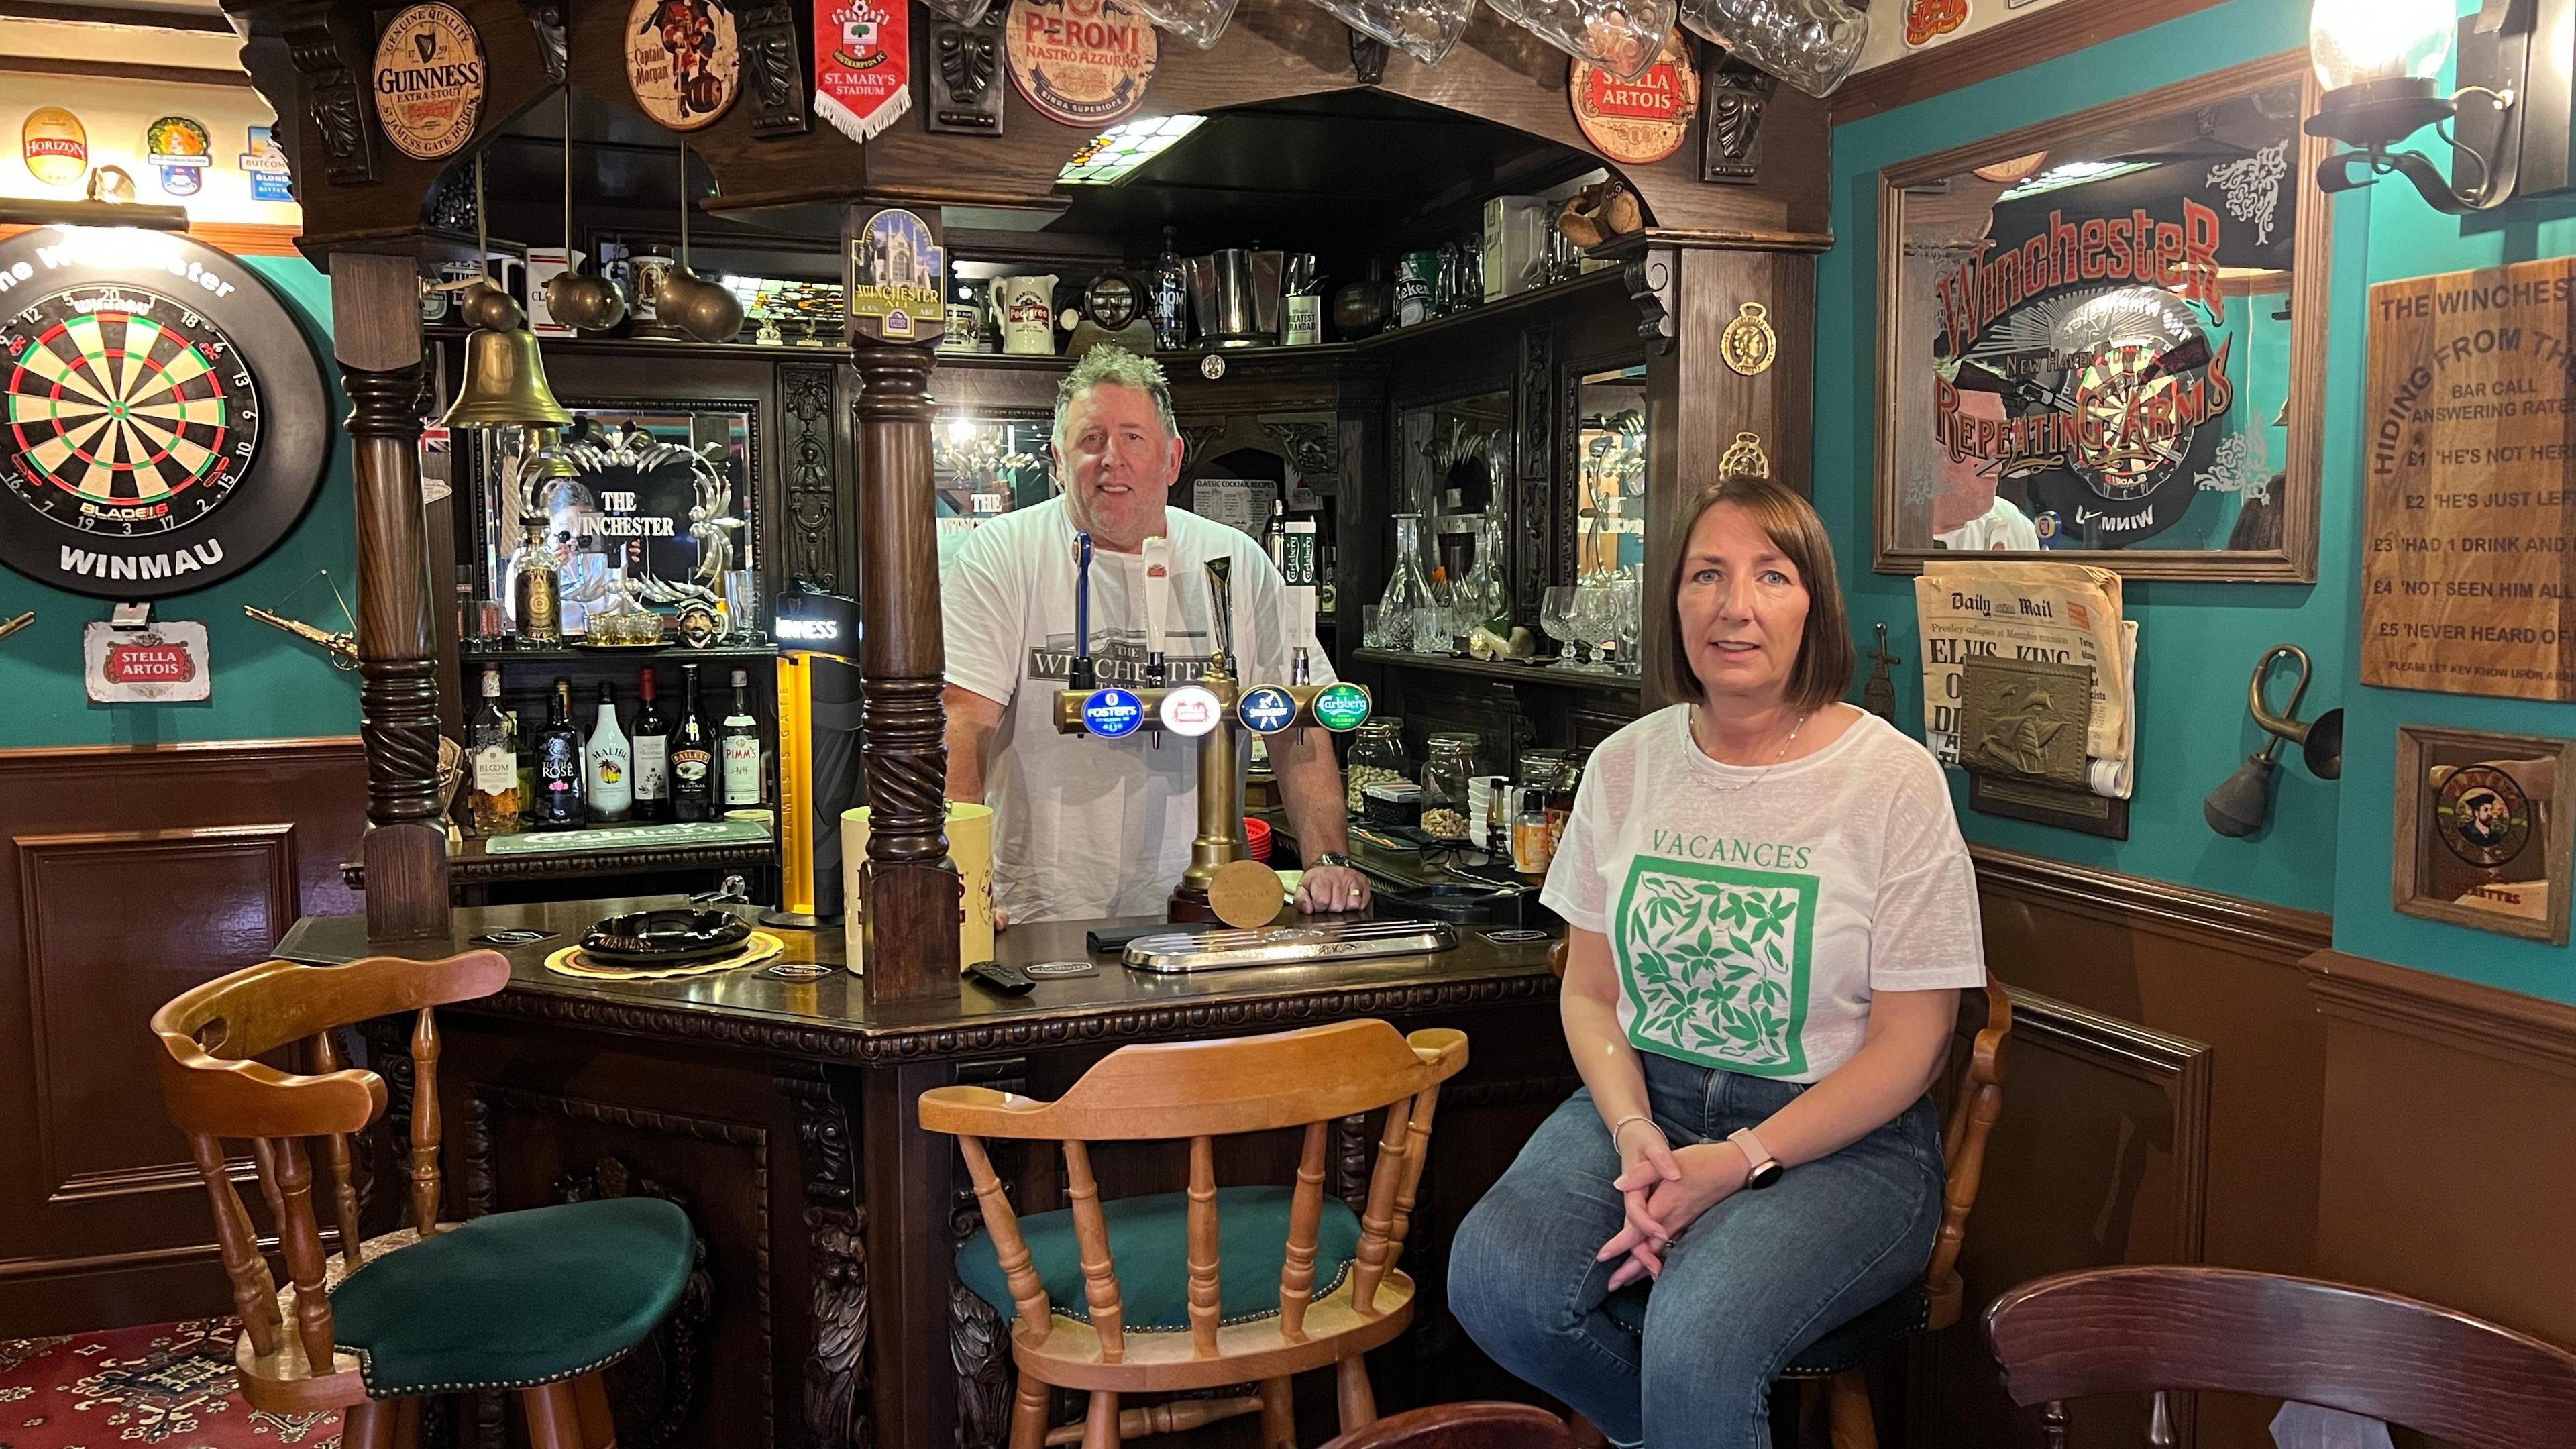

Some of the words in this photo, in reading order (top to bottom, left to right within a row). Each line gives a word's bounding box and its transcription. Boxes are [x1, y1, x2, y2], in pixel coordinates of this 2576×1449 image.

[386, 10, 425, 52] GENUINE
[428, 8, 470, 44] QUALITY
[1025, 12, 1140, 54] PERONI
[635, 44, 665, 66] Captain
[1026, 45, 1077, 62] NASTRO
[1080, 51, 1139, 68] AZZURRO
[378, 62, 479, 95] GUINNESS
[636, 64, 668, 86] Morgan
[824, 73, 843, 84] ST.
[845, 74, 896, 85] MARY'S
[397, 91, 429, 103] EXTRA
[431, 87, 461, 99] STOUT
[837, 86, 885, 95] STADIUM
[1041, 91, 1069, 110] BIRRA
[1072, 97, 1122, 113] SUPERIORE
[1603, 90, 1671, 109] ARTOIS
[27, 140, 85, 160] HORIZON
[424, 138, 451, 152] GATE
[101, 288, 120, 302] 20
[857, 284, 938, 303] WINCHESTER
[1402, 282, 1430, 299] eken
[62, 292, 74, 307] 5
[2381, 294, 2430, 321] THE
[2438, 278, 2575, 315] WINCHES
[22, 308, 43, 324] 12
[180, 311, 199, 328] 18
[212, 340, 226, 353] 4
[2006, 354, 2042, 376] NEW
[2047, 349, 2096, 372] HAVEN
[233, 371, 250, 388] 13
[2452, 384, 2486, 399] BAR
[2493, 378, 2537, 395] CALL
[1935, 370, 2104, 478] REPEATING
[2120, 332, 2232, 463] ARMS
[2374, 366, 2432, 474] HIDING
[2434, 327, 2522, 371] FROM
[2412, 402, 2516, 423] ANSWERING
[235, 441, 252, 458] 10
[2407, 451, 2426, 467] £1
[2487, 447, 2524, 463] NOT
[5, 472, 23, 489] 16
[217, 472, 235, 489] 15
[41, 500, 54, 513] 7
[196, 499, 210, 512] 2
[601, 491, 637, 511] THE
[971, 494, 1002, 513] THE
[2406, 496, 2424, 509] £2
[2483, 492, 2531, 508] JUST
[77, 515, 95, 531] 19
[122, 522, 133, 535] 3
[158, 515, 175, 530] 17
[2374, 539, 2392, 552] £3
[2449, 539, 2455, 551] 1
[2462, 537, 2520, 553] DRINK
[2525, 538, 2566, 553] AND
[60, 538, 224, 580] WINMAU
[1287, 537, 1300, 583] Carlsberg
[1303, 537, 1315, 583] Carlsberg
[2374, 581, 2392, 594] £4
[2446, 582, 2493, 596] SEEN
[2499, 584, 2533, 598] HIM
[2539, 584, 2575, 599] ALL
[1952, 592, 1991, 618] Daily
[2019, 598, 2053, 618] Mail
[1932, 623, 1964, 635] Presley
[1966, 626, 1995, 637] collapses
[2006, 629, 2037, 641] Memphis
[2039, 635, 2068, 644] mansion
[2379, 623, 2398, 637] £5
[2471, 626, 2534, 643] HEARD
[121, 652, 177, 663] STELLA
[1116, 645, 1139, 657] THE
[122, 663, 179, 675] ARTOIS
[2389, 661, 2426, 672] PLEASE
[2429, 663, 2447, 673] LET
[2474, 667, 2509, 678] KNOW
[1319, 695, 1366, 712] Carlsberg
[780, 687, 790, 739] GATE
[592, 747, 629, 761] MALIBU
[673, 751, 710, 763] BAILEYS
[727, 746, 756, 759] PIMM'S
[479, 764, 508, 772] BLOOM
[542, 767, 574, 779] ROSE
[1654, 829, 1811, 869] VACANCES
